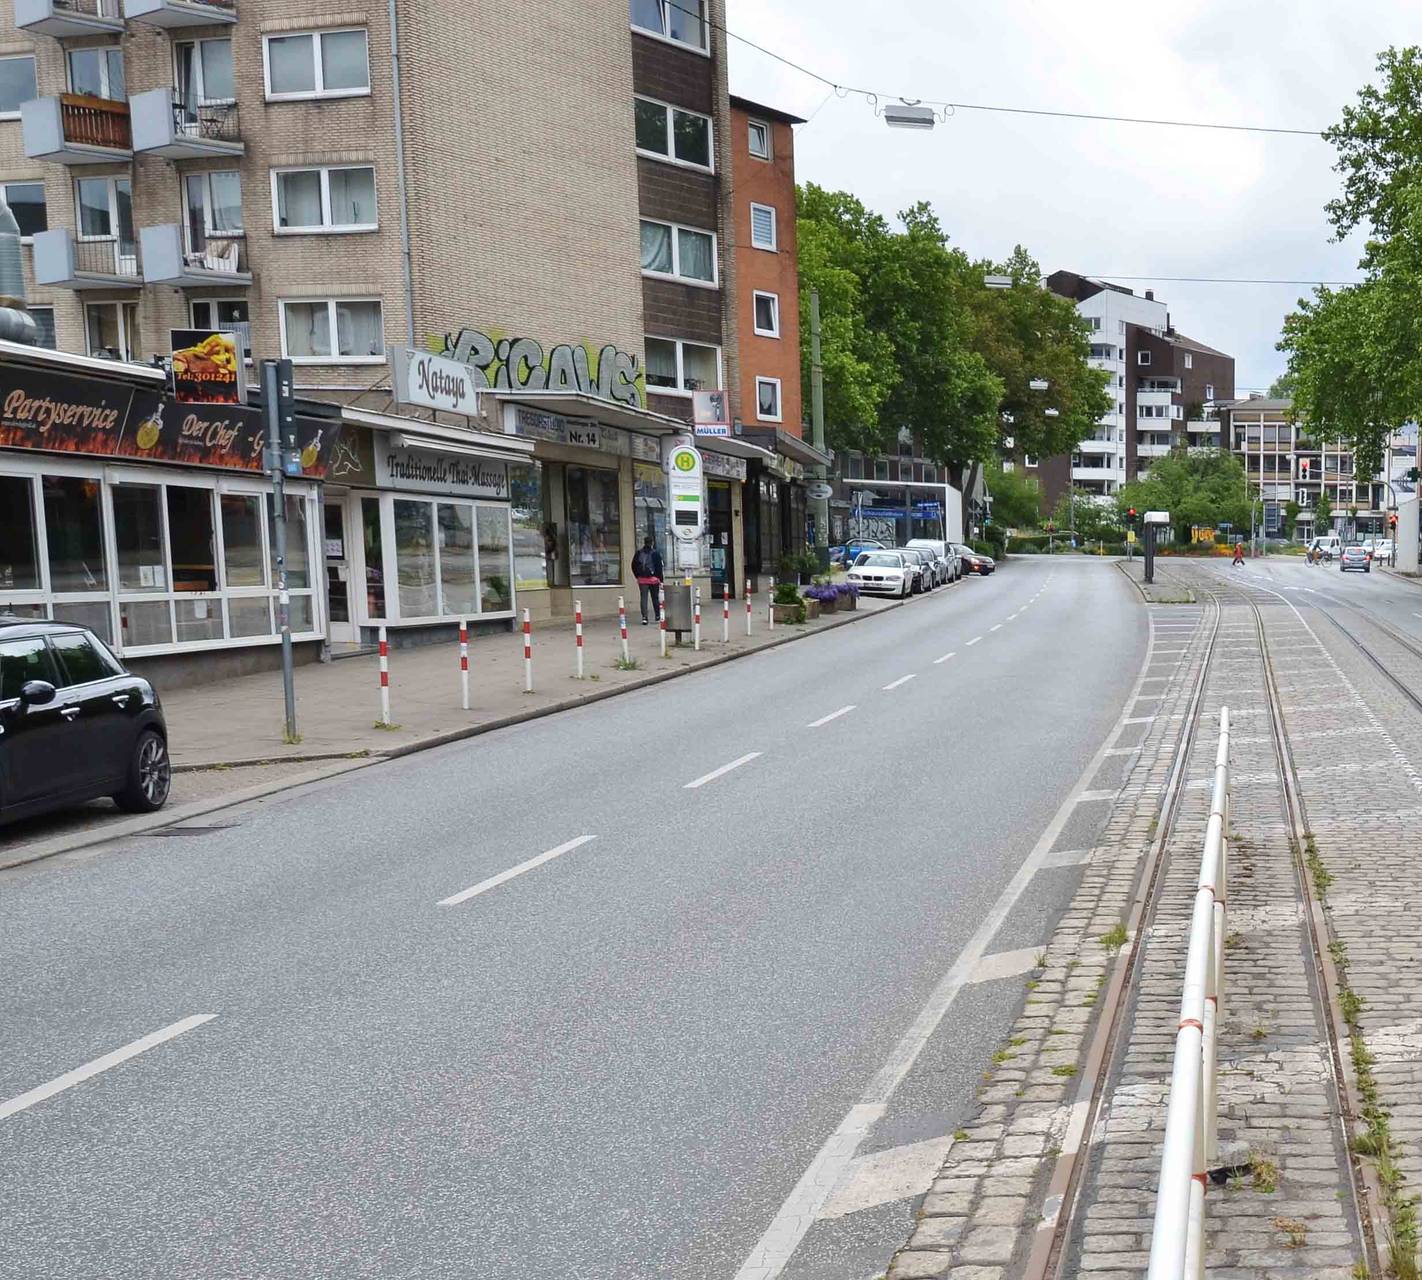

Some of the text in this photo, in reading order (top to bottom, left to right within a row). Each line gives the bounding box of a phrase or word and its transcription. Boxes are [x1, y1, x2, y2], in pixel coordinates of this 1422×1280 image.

[418, 358, 466, 408] Nataya
[3, 389, 119, 432] Partyservice
[182, 413, 209, 437] Der
[205, 421, 243, 454] Chef
[569, 431, 584, 444] Nr.
[586, 433, 597, 445] 14
[697, 427, 727, 436] MÜLLER
[387, 453, 506, 495] Traditionelle Thai-Massage
